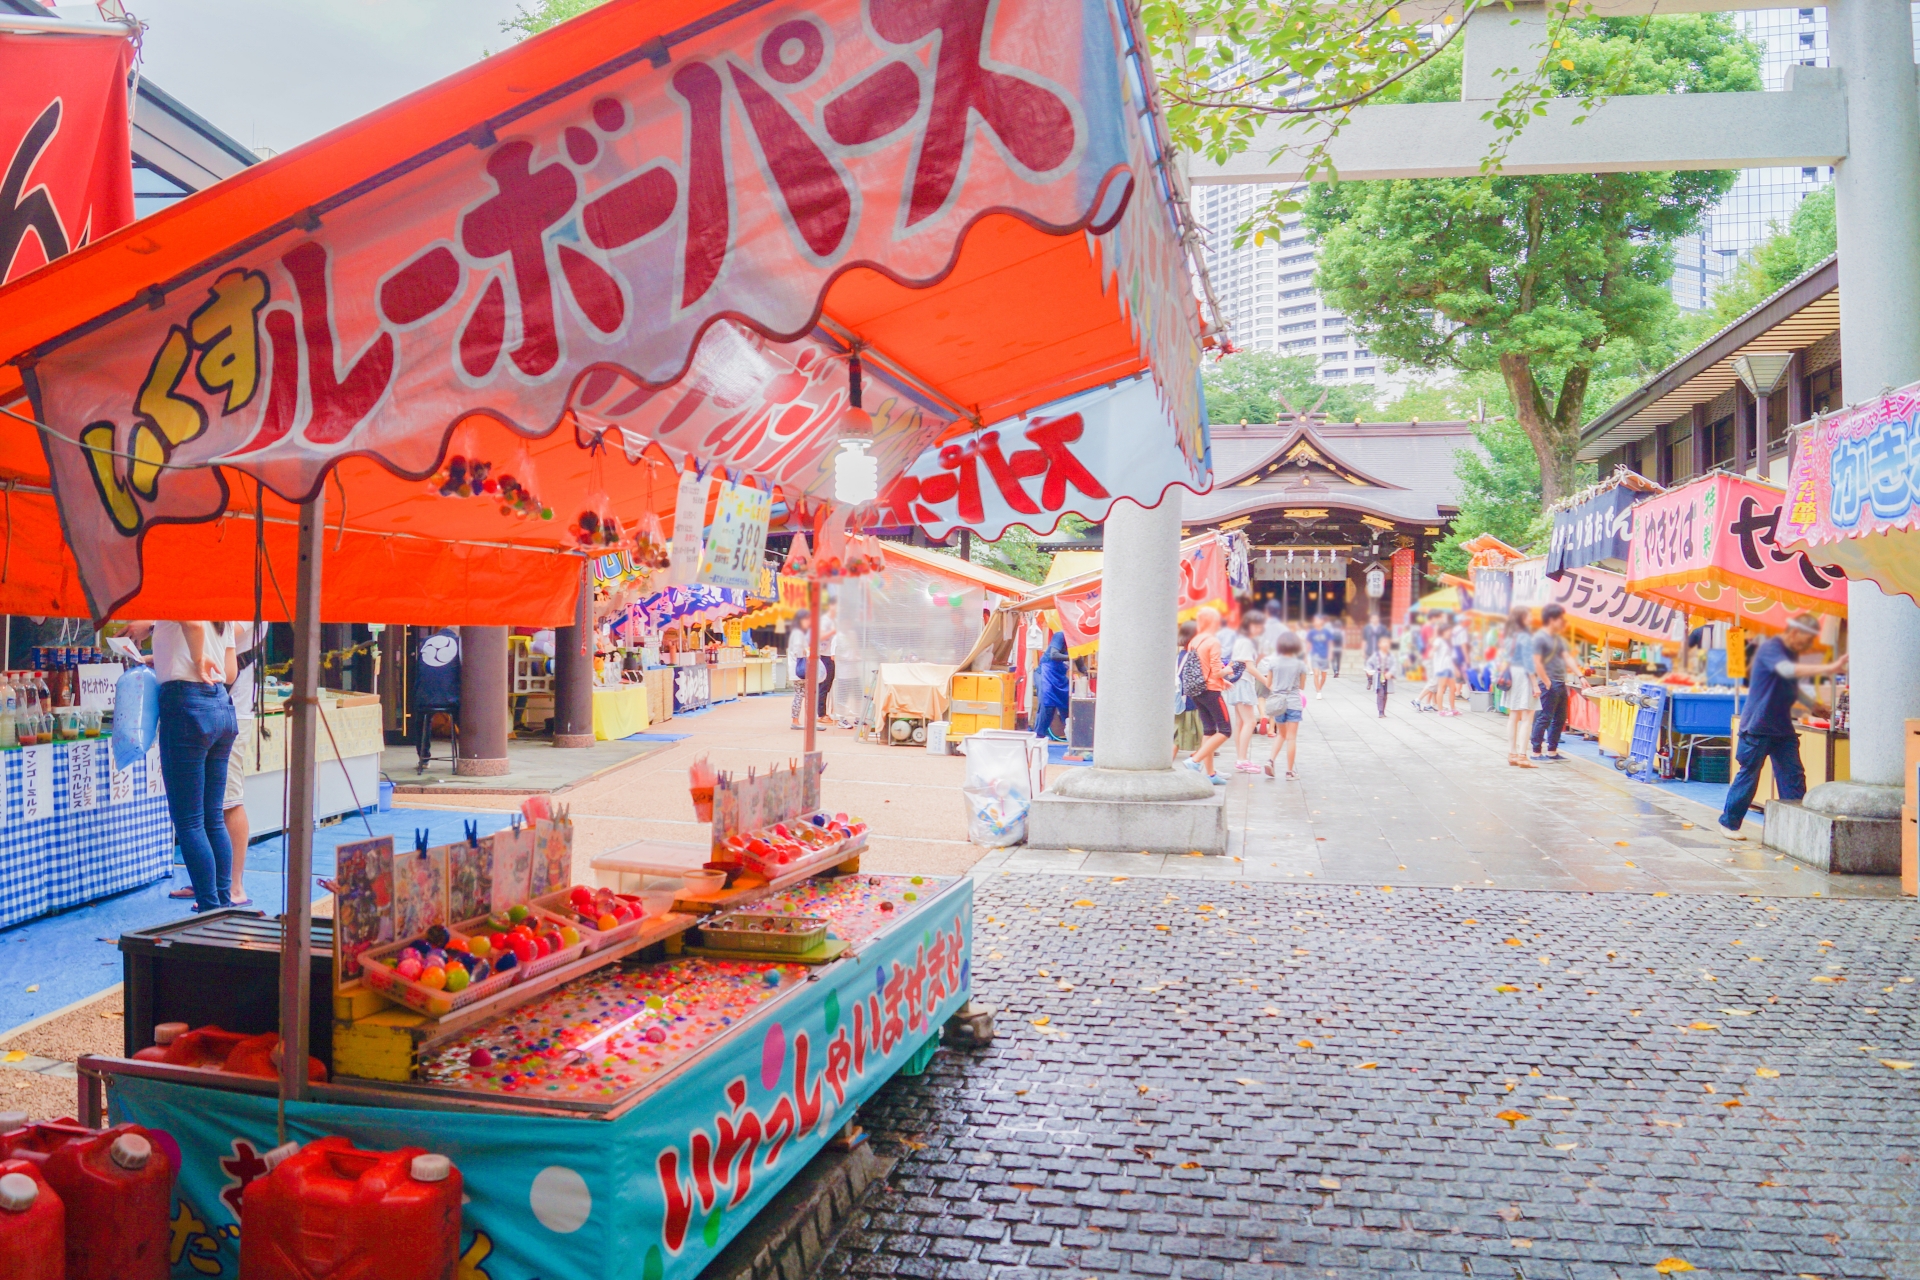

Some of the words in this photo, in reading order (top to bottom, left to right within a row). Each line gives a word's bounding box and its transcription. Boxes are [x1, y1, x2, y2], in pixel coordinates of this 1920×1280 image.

[1832, 418, 1920, 520] かき
[737, 522, 761, 548] 300
[1644, 499, 1698, 568] やきそば
[732, 547, 757, 572] 500
[82, 678, 117, 694] タピオカジュ
[26, 750, 37, 816] マンゴーミルク
